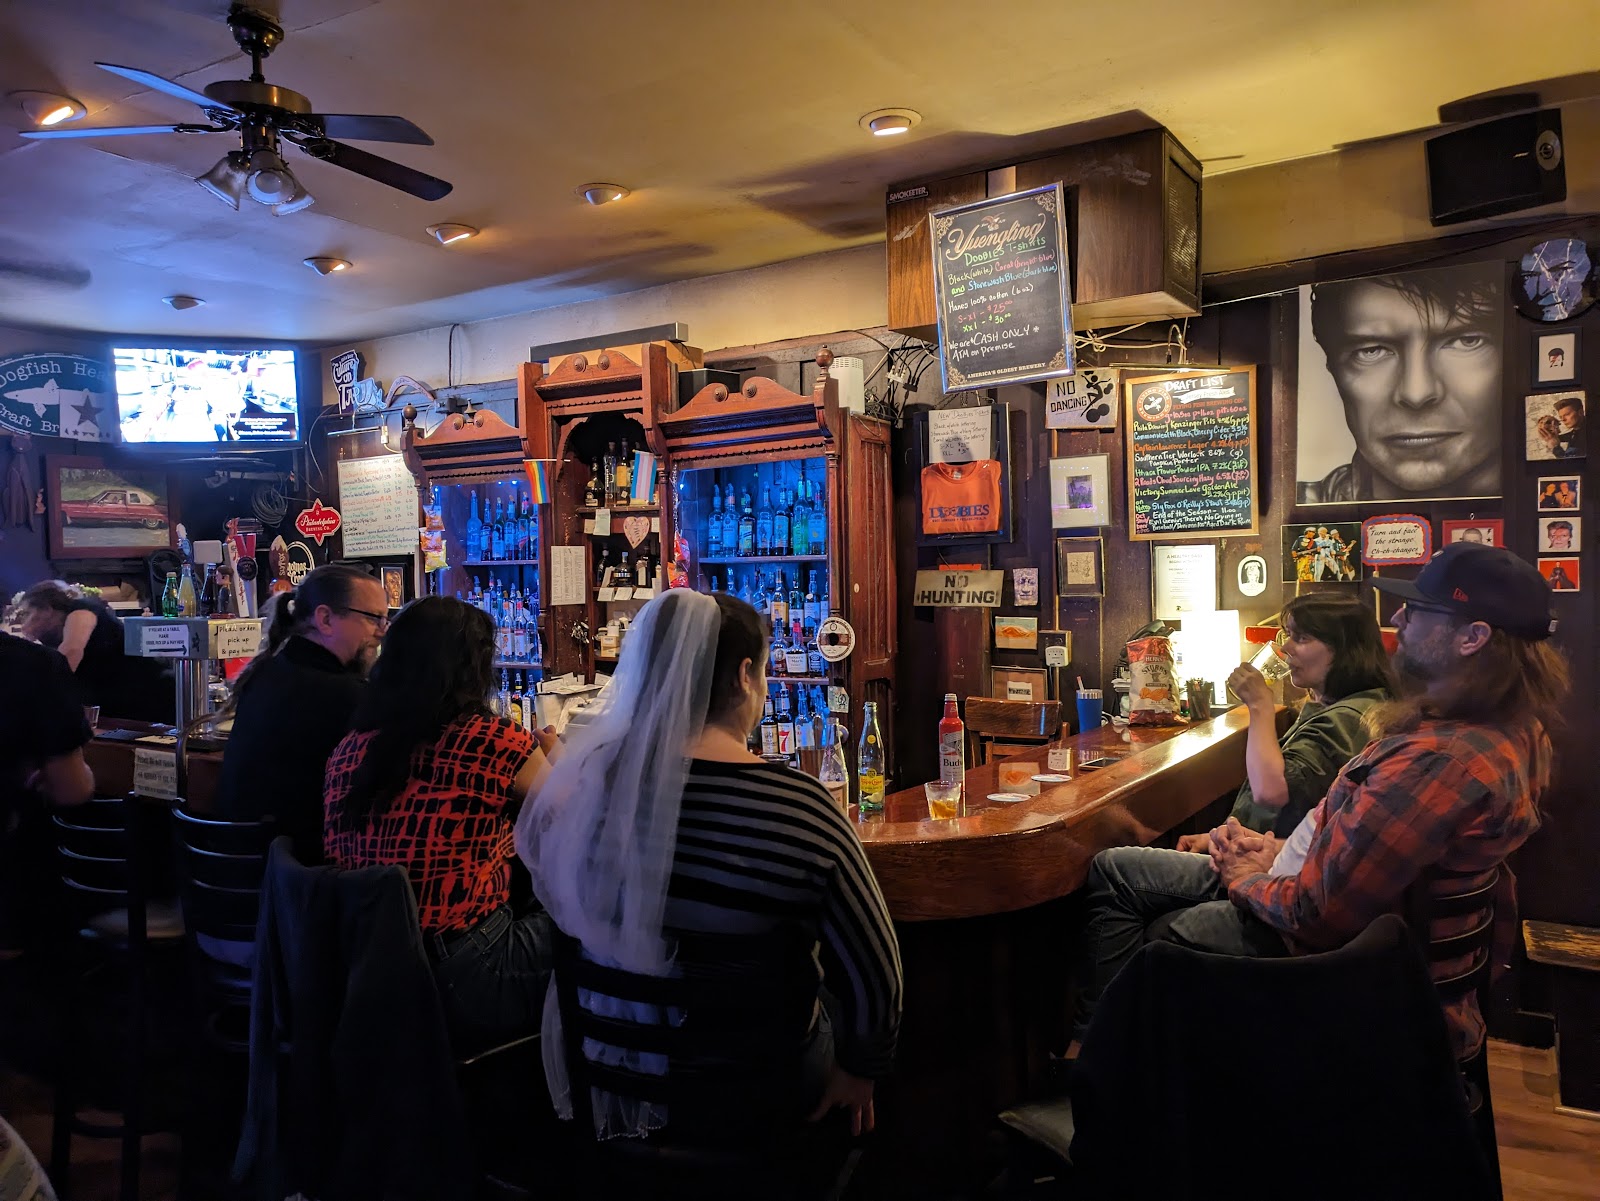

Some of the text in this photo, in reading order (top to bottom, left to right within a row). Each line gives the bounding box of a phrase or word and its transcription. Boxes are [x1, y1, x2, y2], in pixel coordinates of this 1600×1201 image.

[890, 186, 926, 200] SMOKEETER
[946, 213, 1046, 260] Yuengling
[951, 285, 965, 294] and
[948, 301, 968, 313] Hanes
[970, 295, 987, 305] 100%
[1002, 324, 1030, 339] ONLY
[952, 349, 969, 362] ATM
[967, 370, 996, 378] AMERICA'S
[1056, 380, 1075, 396] NO
[1164, 375, 1227, 392] DRAFT LIST
[1051, 396, 1087, 412] DANCING
[1188, 440, 1209, 453] Lager
[300, 514, 336, 526] Philadelphia
[1152, 511, 1166, 519] End
[945, 575, 968, 588] NO
[921, 590, 994, 604] HUNTING
[228, 636, 240, 645] pick
[779, 730, 790, 752] 7
